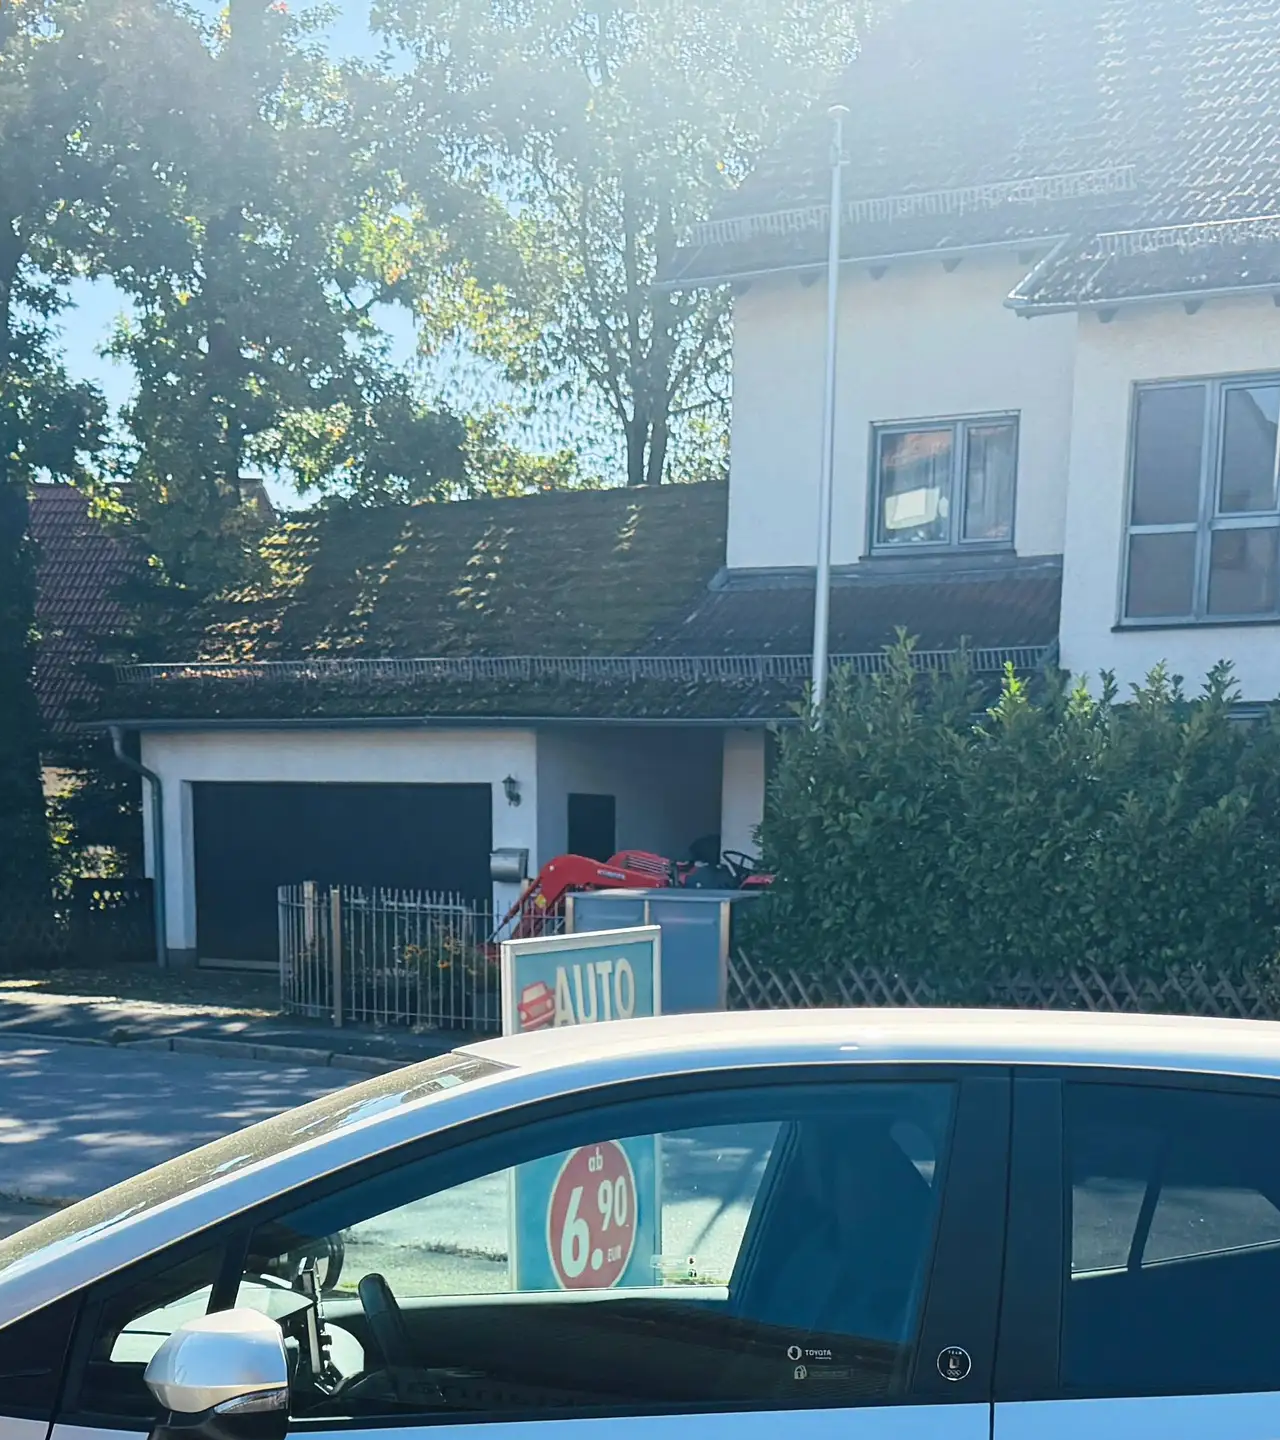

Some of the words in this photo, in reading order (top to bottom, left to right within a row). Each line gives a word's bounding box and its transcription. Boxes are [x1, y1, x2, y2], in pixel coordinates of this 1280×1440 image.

[554, 957, 635, 1028] AUTO
[588, 1146, 604, 1172] ab
[607, 1244, 622, 1262] EUR
